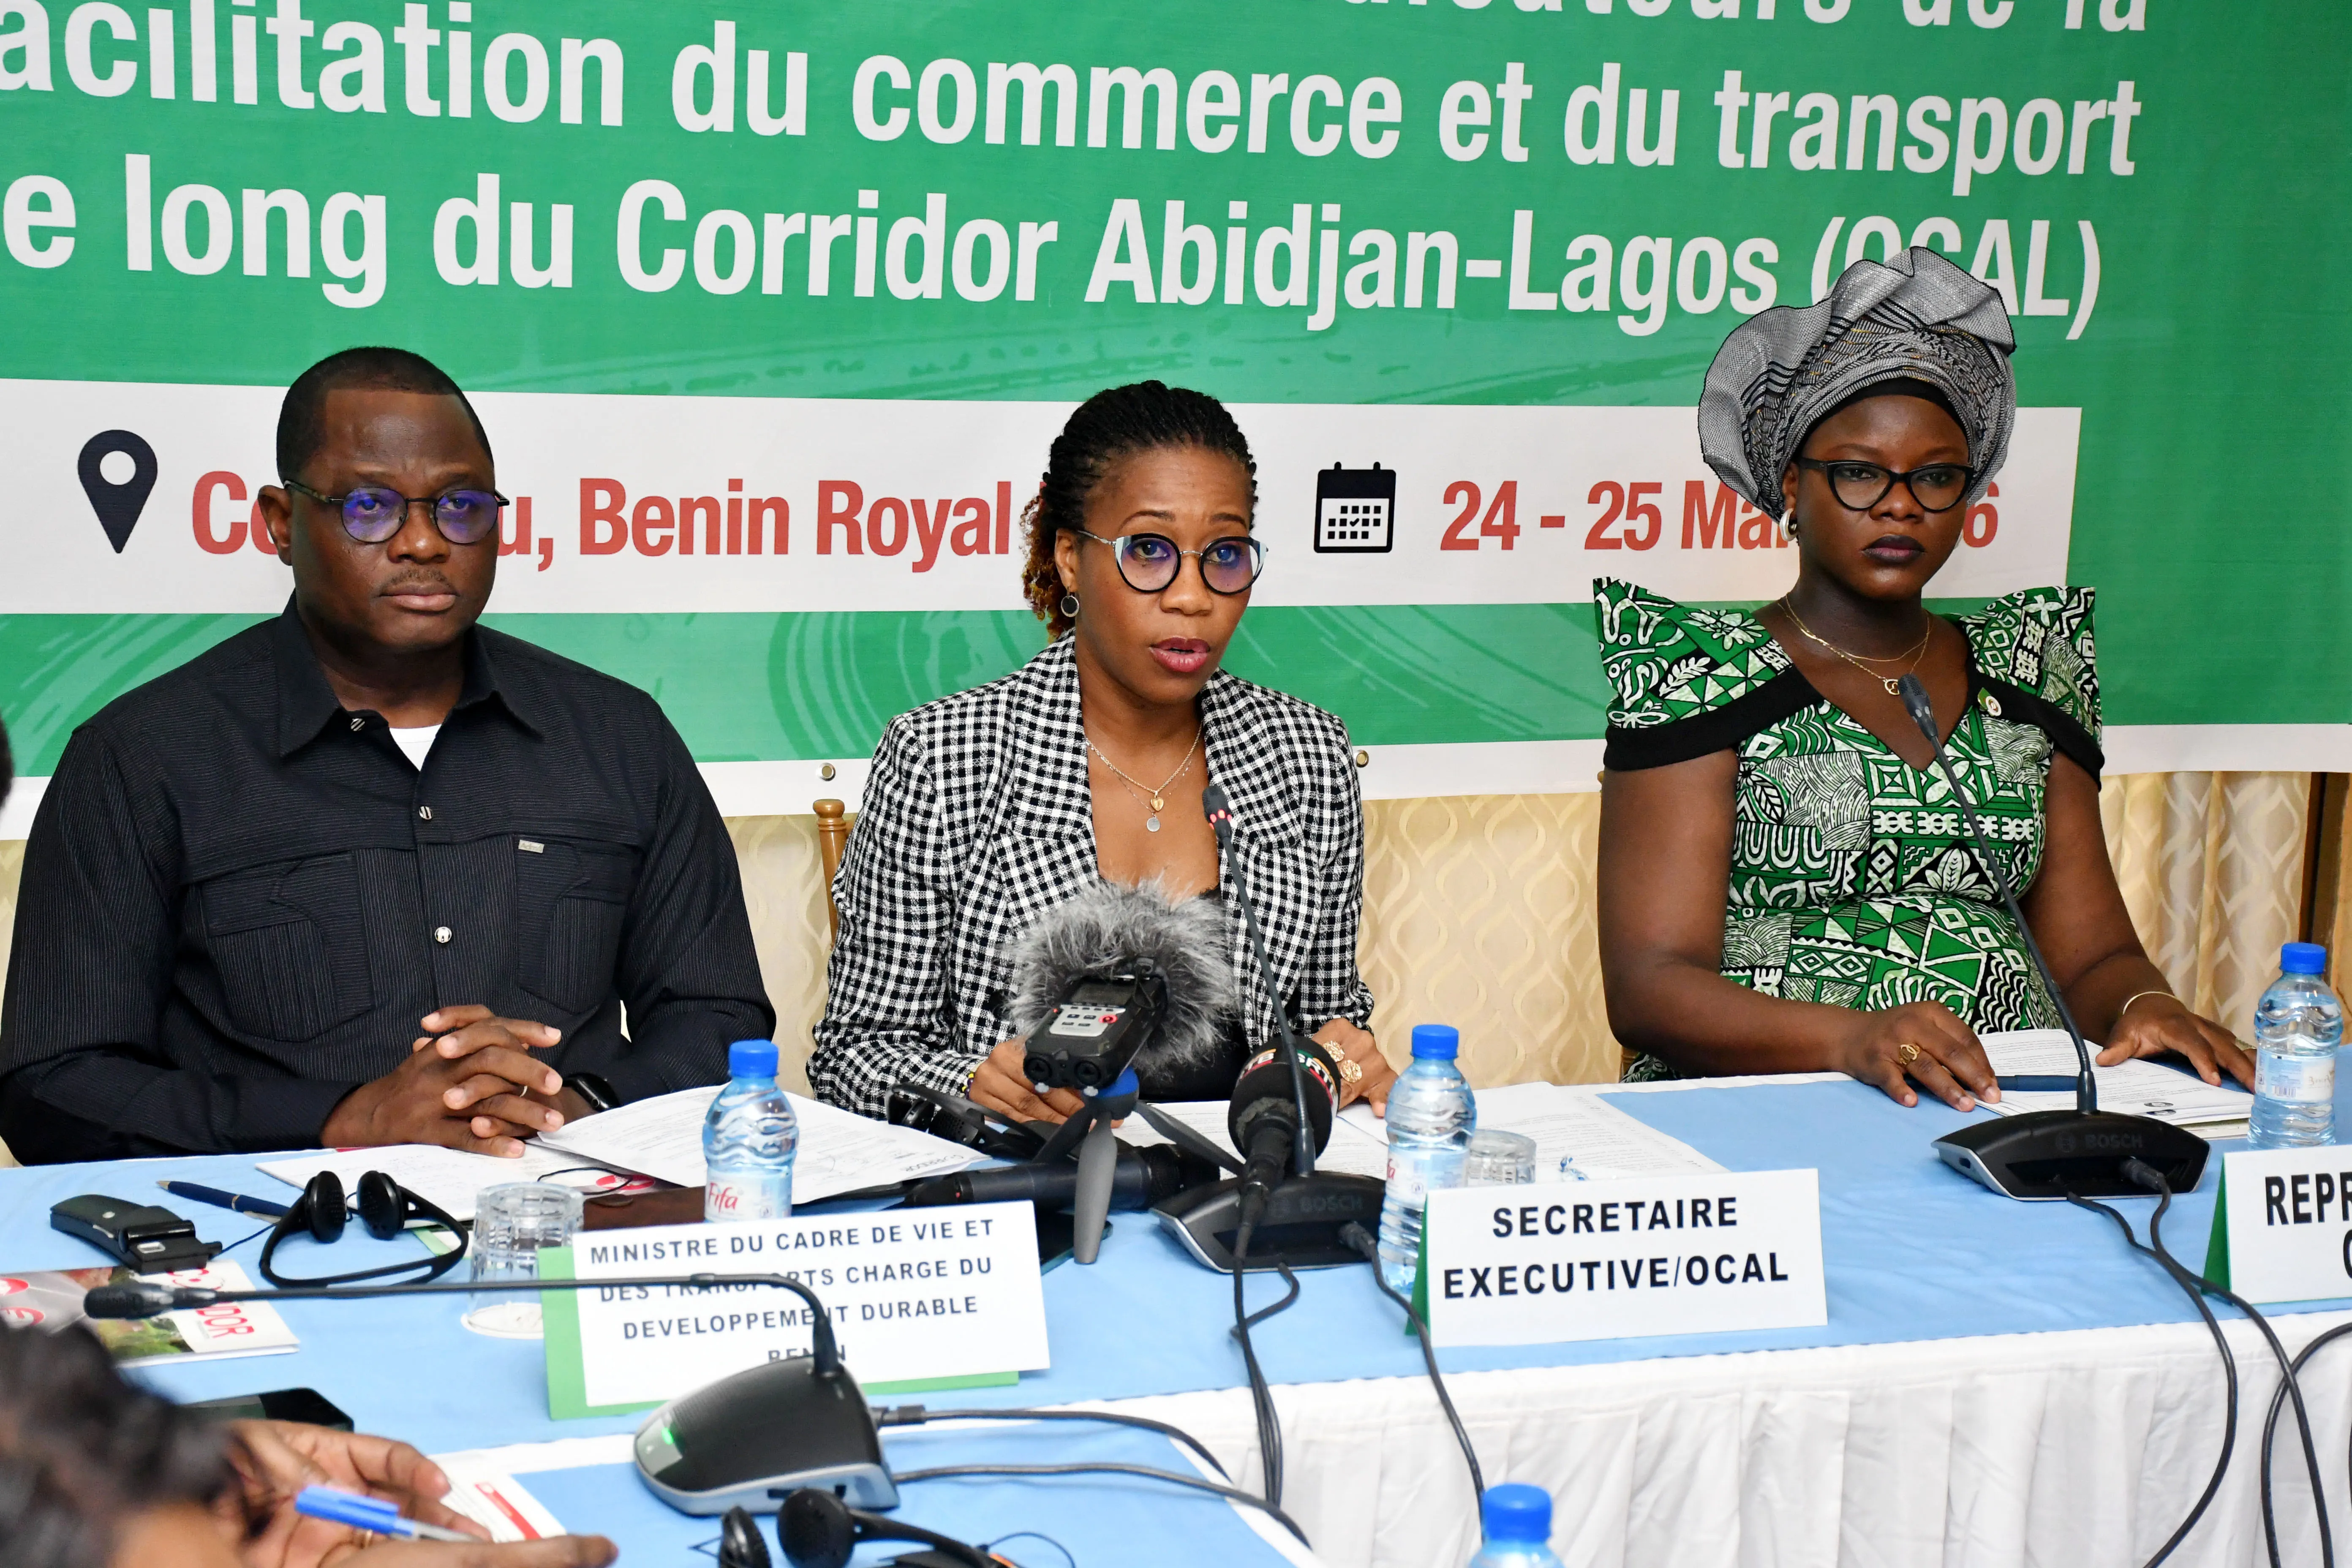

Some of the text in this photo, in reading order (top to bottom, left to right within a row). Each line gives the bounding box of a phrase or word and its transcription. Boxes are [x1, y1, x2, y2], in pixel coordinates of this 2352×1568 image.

[672, 20, 808, 136] du
[853, 55, 1402, 158] commerce
[1439, 62, 1533, 162] et
[1565, 63, 1679, 166] du
[1715, 70, 2141, 196] transport
[3, 175, 76, 268] e
[126, 154, 386, 308] long
[433, 173, 573, 288] du
[617, 180, 1058, 302] Corridor
[1085, 199, 1778, 336] Abidjan-Lagos
[581, 479, 789, 556] Benin
[817, 481, 1010, 572] Royal
[1441, 481, 1520, 550] 24
[1541, 516, 1565, 527] -
[1585, 481, 1661, 550] 25
[2085, 1134, 2143, 1149] BOSCH
[708, 1182, 738, 1213] Fifa
[1300, 1195, 1363, 1212] BOSCH
[1493, 1197, 1737, 1237] SECRETAIRE
[591, 1219, 993, 1263] MINISTRE DU CADRE DE VIE ET
[601, 1285, 649, 1302] DES
[846, 1260, 947, 1283] CHARGE
[959, 1257, 991, 1275] DU
[1444, 1252, 1788, 1298] EXECUTIVE/OCAL
[861, 1296, 977, 1320] DURABLE
